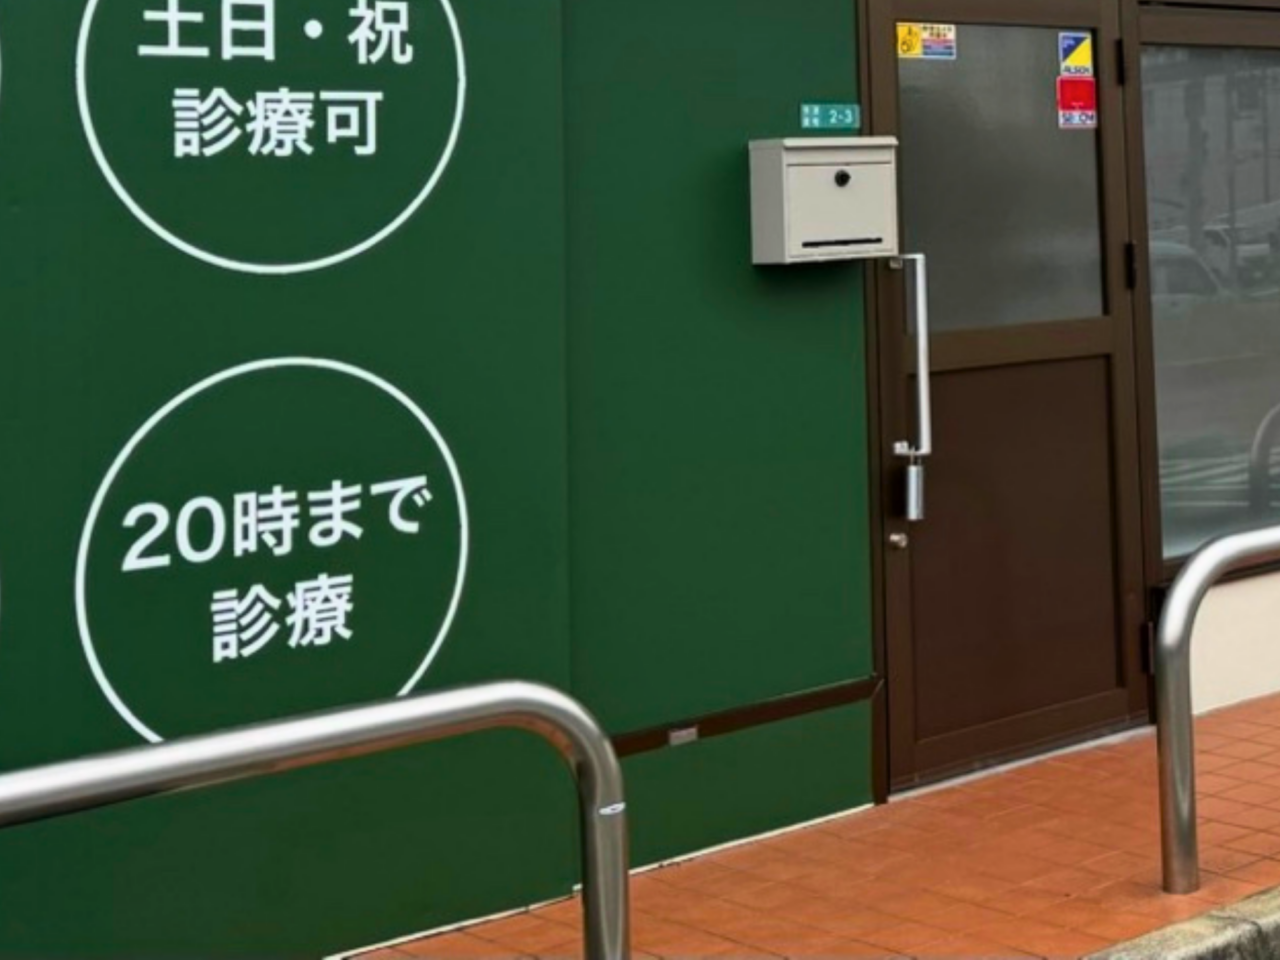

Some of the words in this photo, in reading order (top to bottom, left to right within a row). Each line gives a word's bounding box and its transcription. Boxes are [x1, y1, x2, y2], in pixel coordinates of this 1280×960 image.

[171, 86, 384, 158] 診療可
[121, 475, 433, 572] 20時まで
[210, 572, 354, 663] 診療
